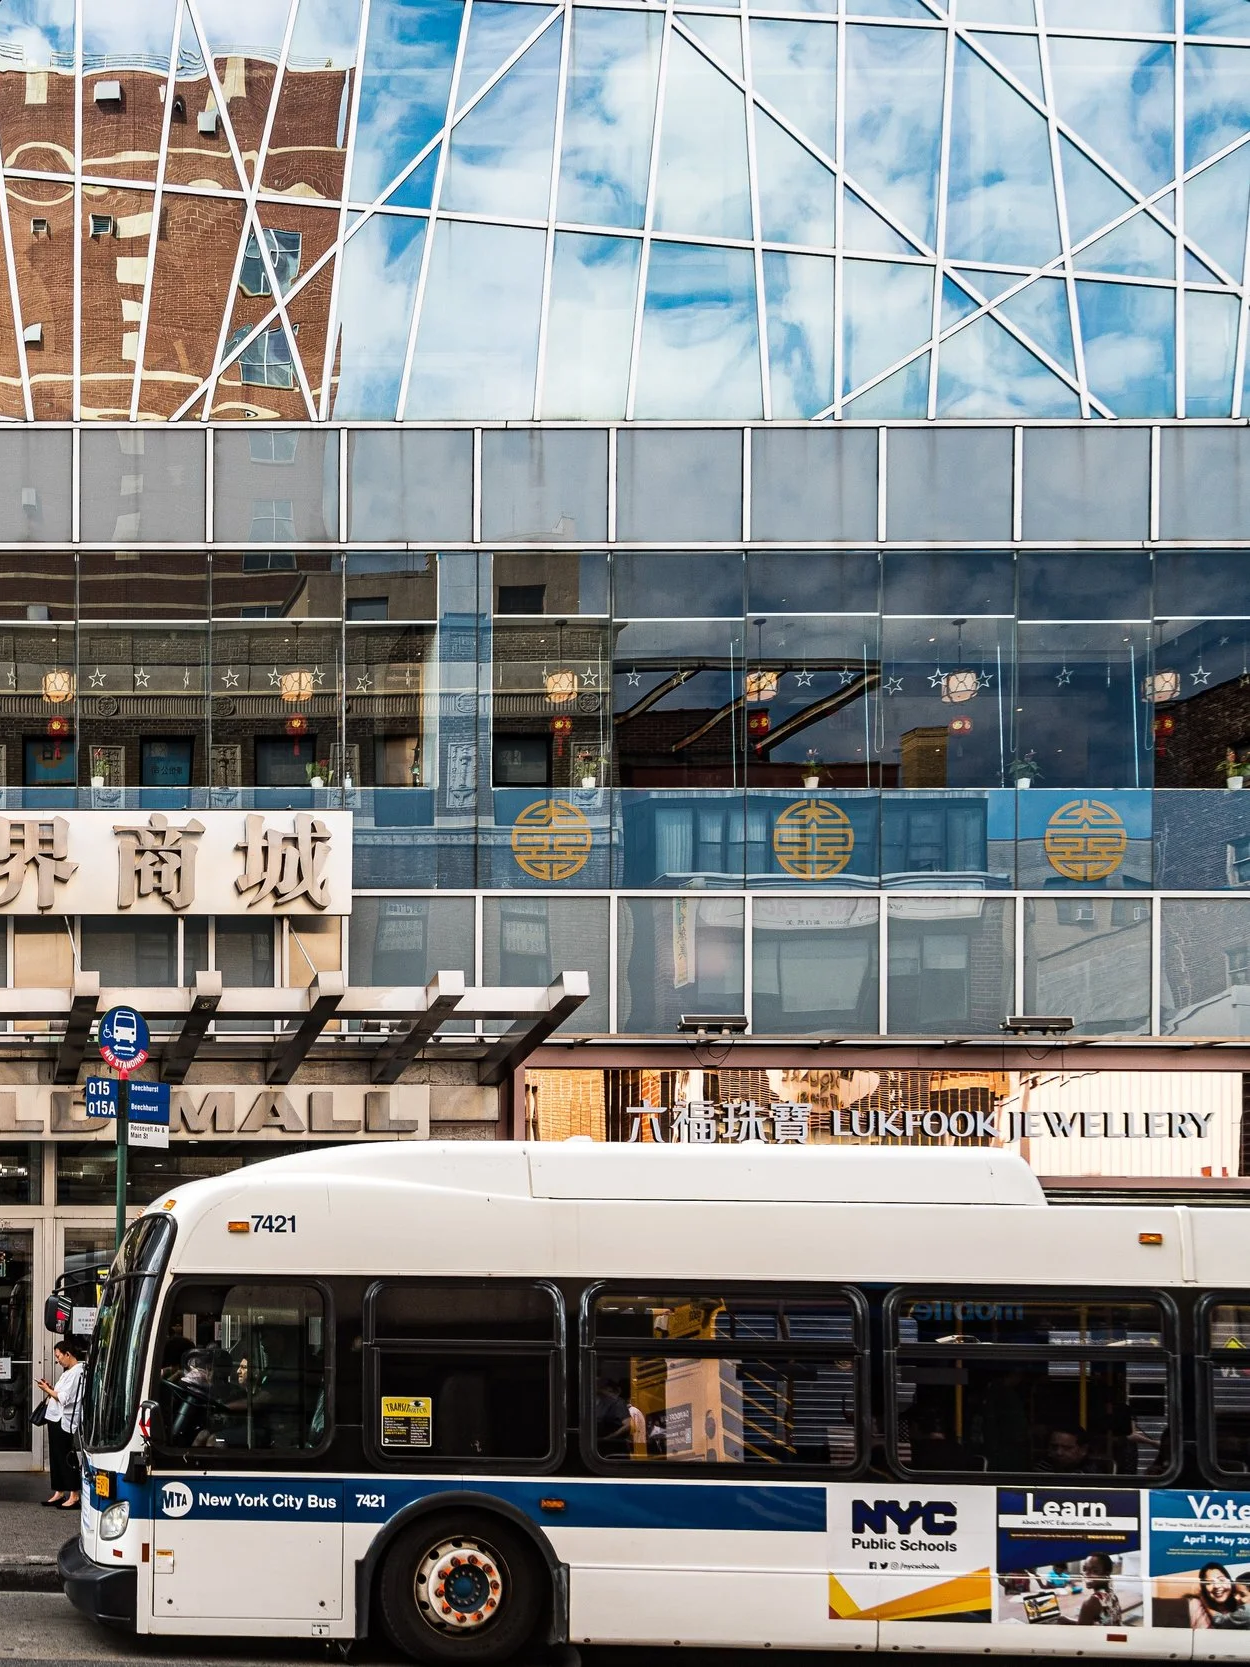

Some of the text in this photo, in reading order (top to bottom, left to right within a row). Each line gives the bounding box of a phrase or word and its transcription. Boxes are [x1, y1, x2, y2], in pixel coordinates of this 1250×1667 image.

[103, 1049, 146, 1070] NO STANDING
[88, 1081, 111, 1096] Q15
[131, 1083, 159, 1093] Beechhurst
[88, 1101, 116, 1116] Q15A
[131, 1103, 159, 1112] Beechhurst
[170, 1091, 419, 1133] MALL
[130, 1124, 153, 1133] Roosevelt
[626, 1101, 813, 1144] 六福珠寶
[830, 1109, 1215, 1143] LUKFOOK JEWELLERY
[130, 1131, 142, 1140] Main
[251, 1214, 298, 1234] 7421
[163, 1489, 187, 1509] MTA
[198, 1492, 337, 1511] New York City Bus
[355, 1493, 386, 1508] 7421
[1026, 1492, 1107, 1518] Learn
[1187, 1495, 1250, 1521] Vote
[852, 1499, 957, 1535] NYC
[852, 1538, 957, 1552] Public Schools
[1183, 1534, 1207, 1545] April
[1214, 1535, 1236, 1546] May
[1237, 1537, 1250, 1545] 20
